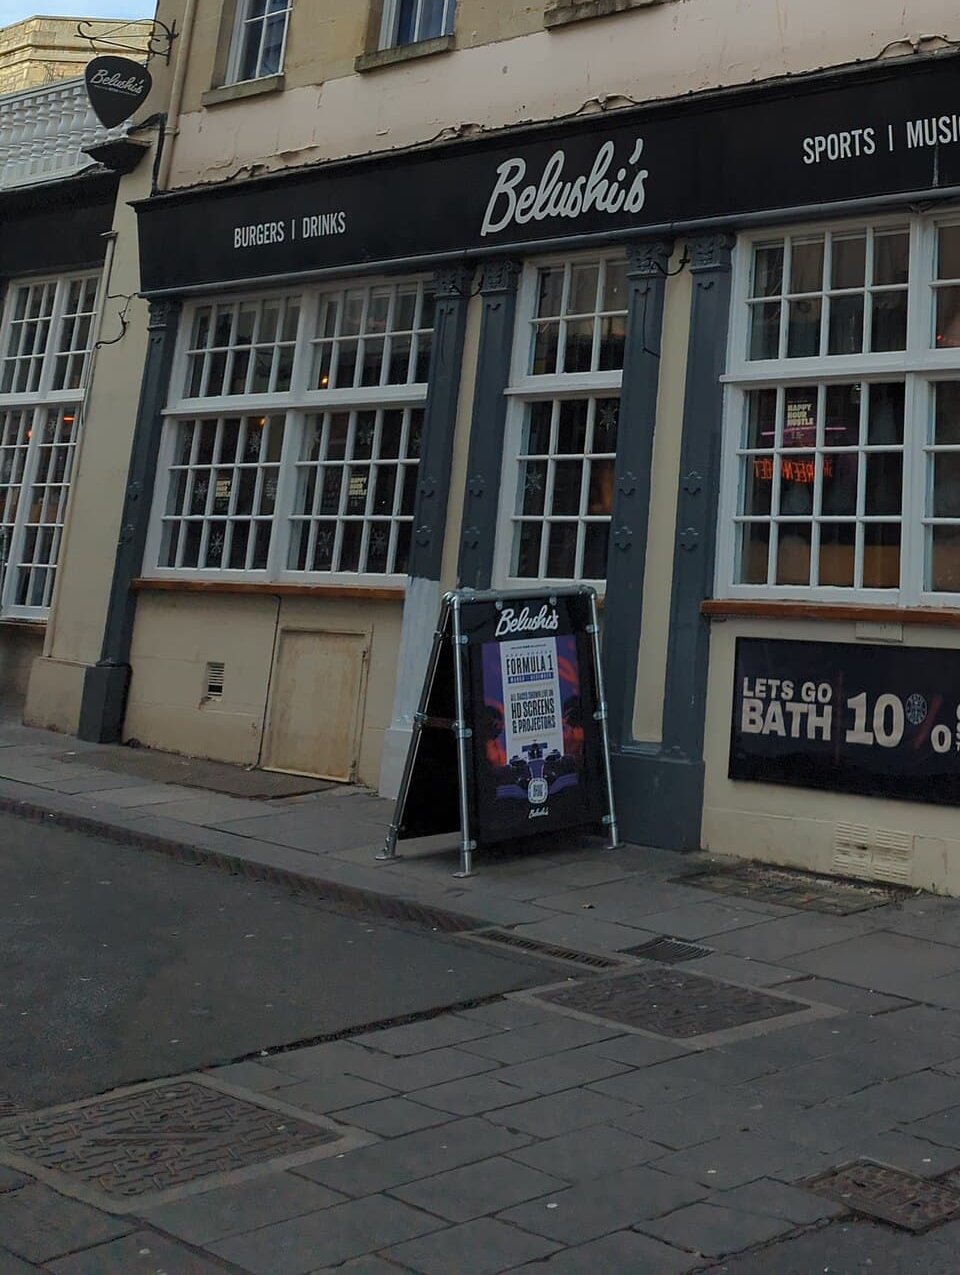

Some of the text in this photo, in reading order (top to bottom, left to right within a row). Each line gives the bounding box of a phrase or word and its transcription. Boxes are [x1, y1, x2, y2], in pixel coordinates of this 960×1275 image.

[90, 69, 145, 94] Belushi's
[803, 128, 876, 165] SPORTS
[481, 138, 649, 237] Belushi's
[234, 221, 285, 248] BURGERS
[302, 211, 346, 238] DRINKS
[495, 604, 559, 637] Belushi's
[506, 655, 553, 676] FORMULA 1
[743, 677, 832, 703] LETS GO
[511, 698, 555, 719] HD SCREENS
[741, 698, 832, 741] BATH
[518, 715, 556, 733] PROJECTORS
